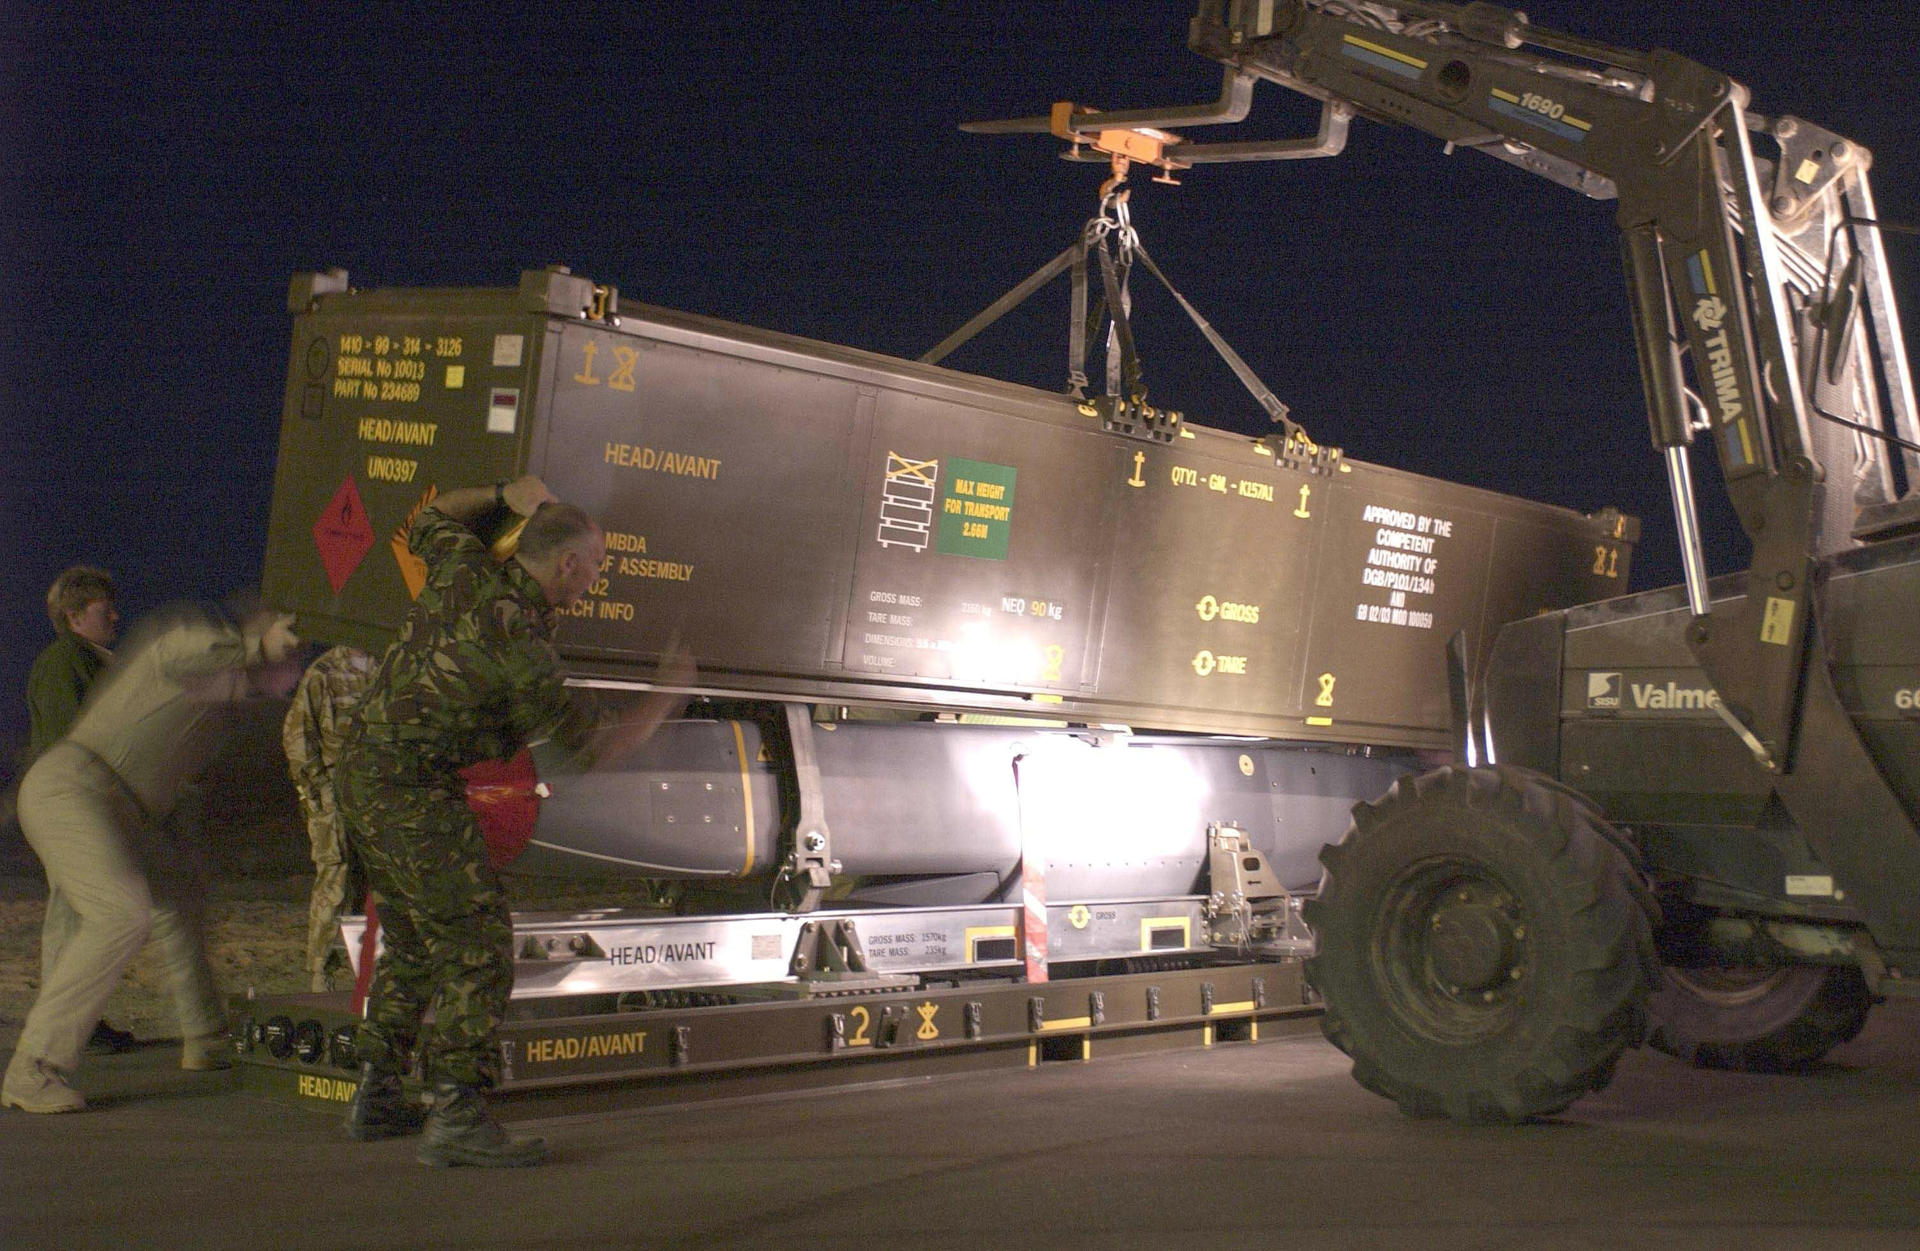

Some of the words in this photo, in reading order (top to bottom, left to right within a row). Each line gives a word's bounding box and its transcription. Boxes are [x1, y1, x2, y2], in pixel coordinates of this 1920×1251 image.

[1520, 92, 1566, 119] 1690
[338, 355, 373, 377] SERIAL
[376, 359, 392, 377] No
[393, 359, 425, 381] 10013
[1705, 329, 1743, 423] TRIMA
[334, 377, 361, 399] PART
[363, 381, 378, 399] No
[358, 418, 438, 446] HEAD/AVANT
[605, 442, 722, 480] HEAD/AVANT
[955, 478, 975, 496] MAX
[976, 482, 1005, 500] HEIGHT
[944, 498, 962, 515] FOR
[964, 501, 1010, 521] TRANSPORT
[1363, 505, 1416, 530] APPROVED
[1417, 515, 1432, 533] BY
[1434, 518, 1453, 538] THE
[605, 532, 647, 553] MBDA
[1376, 528, 1435, 554] COMPETENT
[619, 557, 694, 581] ASSEMBLY
[1367, 548, 1423, 572] AUTHORITY
[1423, 558, 1438, 575] OF
[870, 591, 897, 604] GROSS
[1002, 597, 1025, 617] NEQ
[1031, 601, 1047, 617] 90
[1048, 602, 1063, 620] kg
[600, 602, 634, 622] INFO
[867, 611, 888, 624] TARE
[1219, 602, 1260, 624] GROSS
[1217, 655, 1247, 675] TARE
[868, 935, 893, 945] GROSS
[610, 942, 716, 966] HEAD/AVANT
[869, 949, 886, 958] TARE
[527, 1032, 647, 1063] HEAD/AVANT
